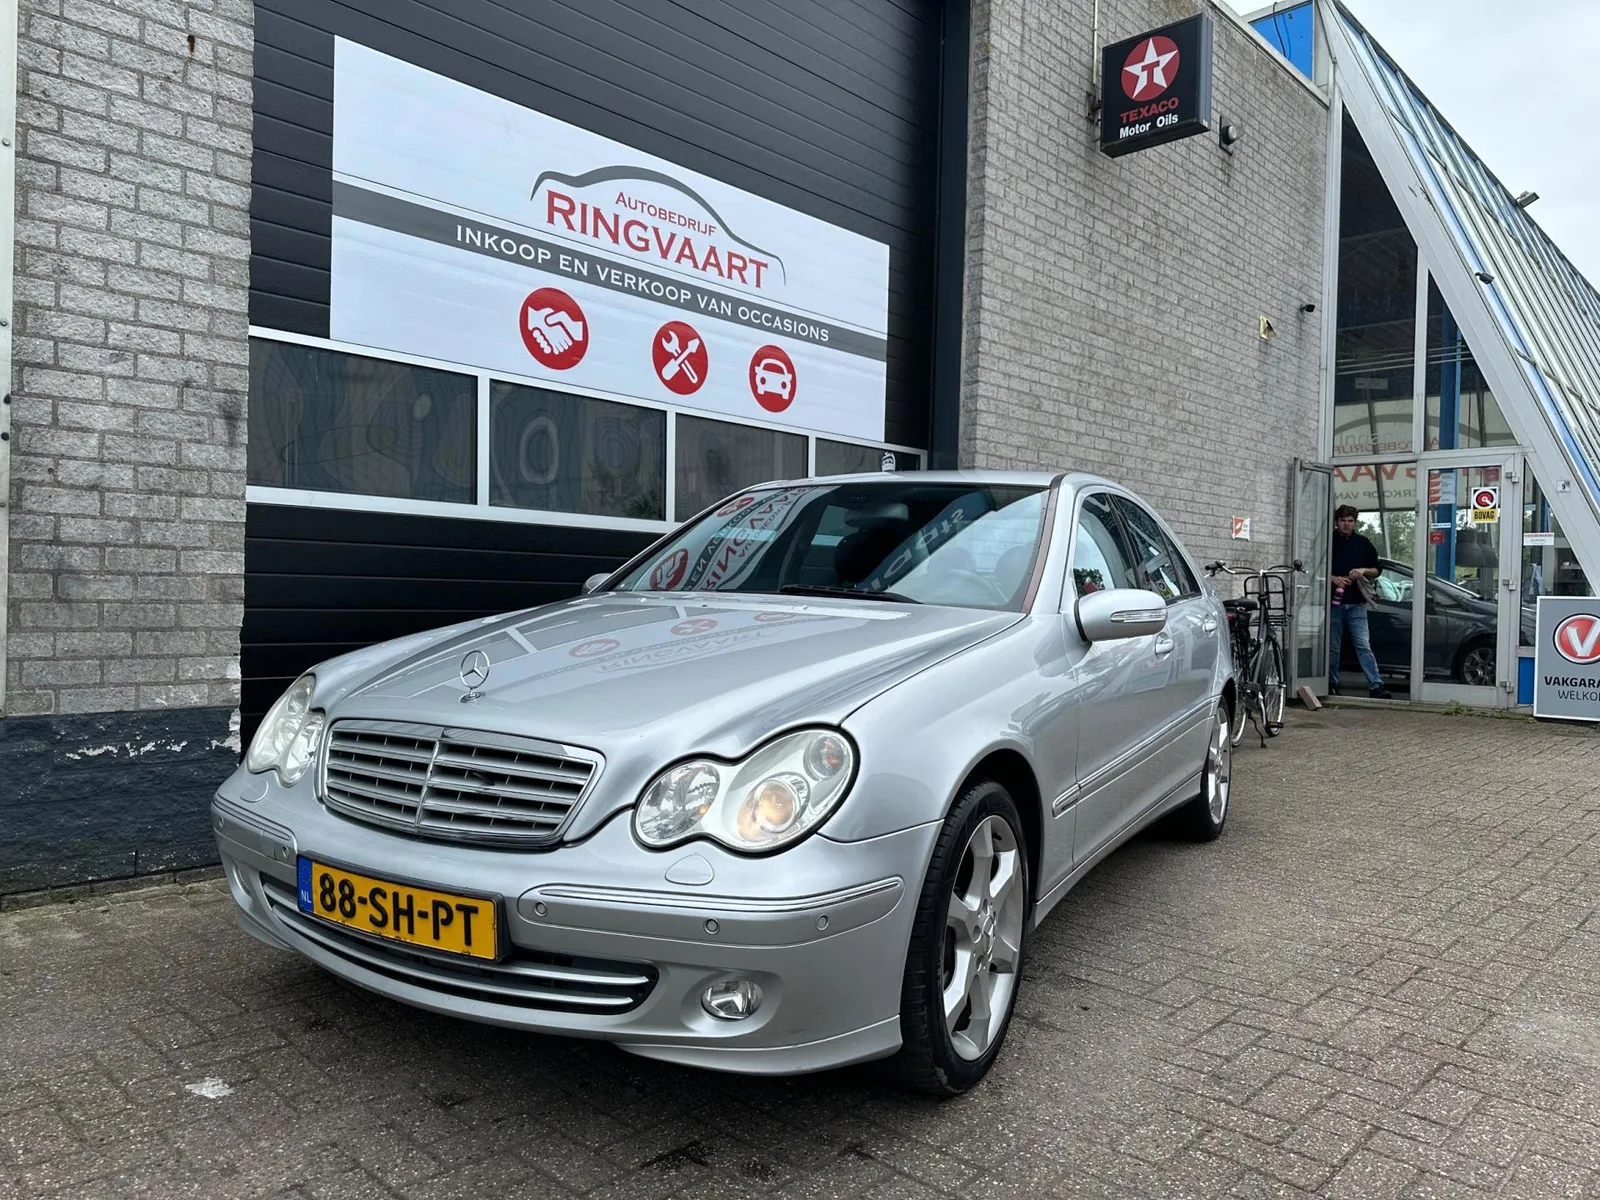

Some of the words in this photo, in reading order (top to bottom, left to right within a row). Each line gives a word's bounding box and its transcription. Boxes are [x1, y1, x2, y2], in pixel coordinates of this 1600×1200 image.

[1121, 97, 1179, 124] TEXACO
[1119, 122, 1151, 139] Motor
[1156, 113, 1178, 128] Oils
[546, 189, 768, 288] RINGVAART
[456, 224, 551, 264] INKOOP
[559, 254, 588, 276] EN
[596, 264, 691, 303] VERKOOP
[697, 293, 732, 317] VAN
[738, 306, 829, 342] OCCASIONS
[1474, 511, 1495, 520] BOVAG
[1557, 690, 1600, 702] WELKO
[301, 890, 312, 904] NL
[319, 872, 479, 947] 88-SH-PT
